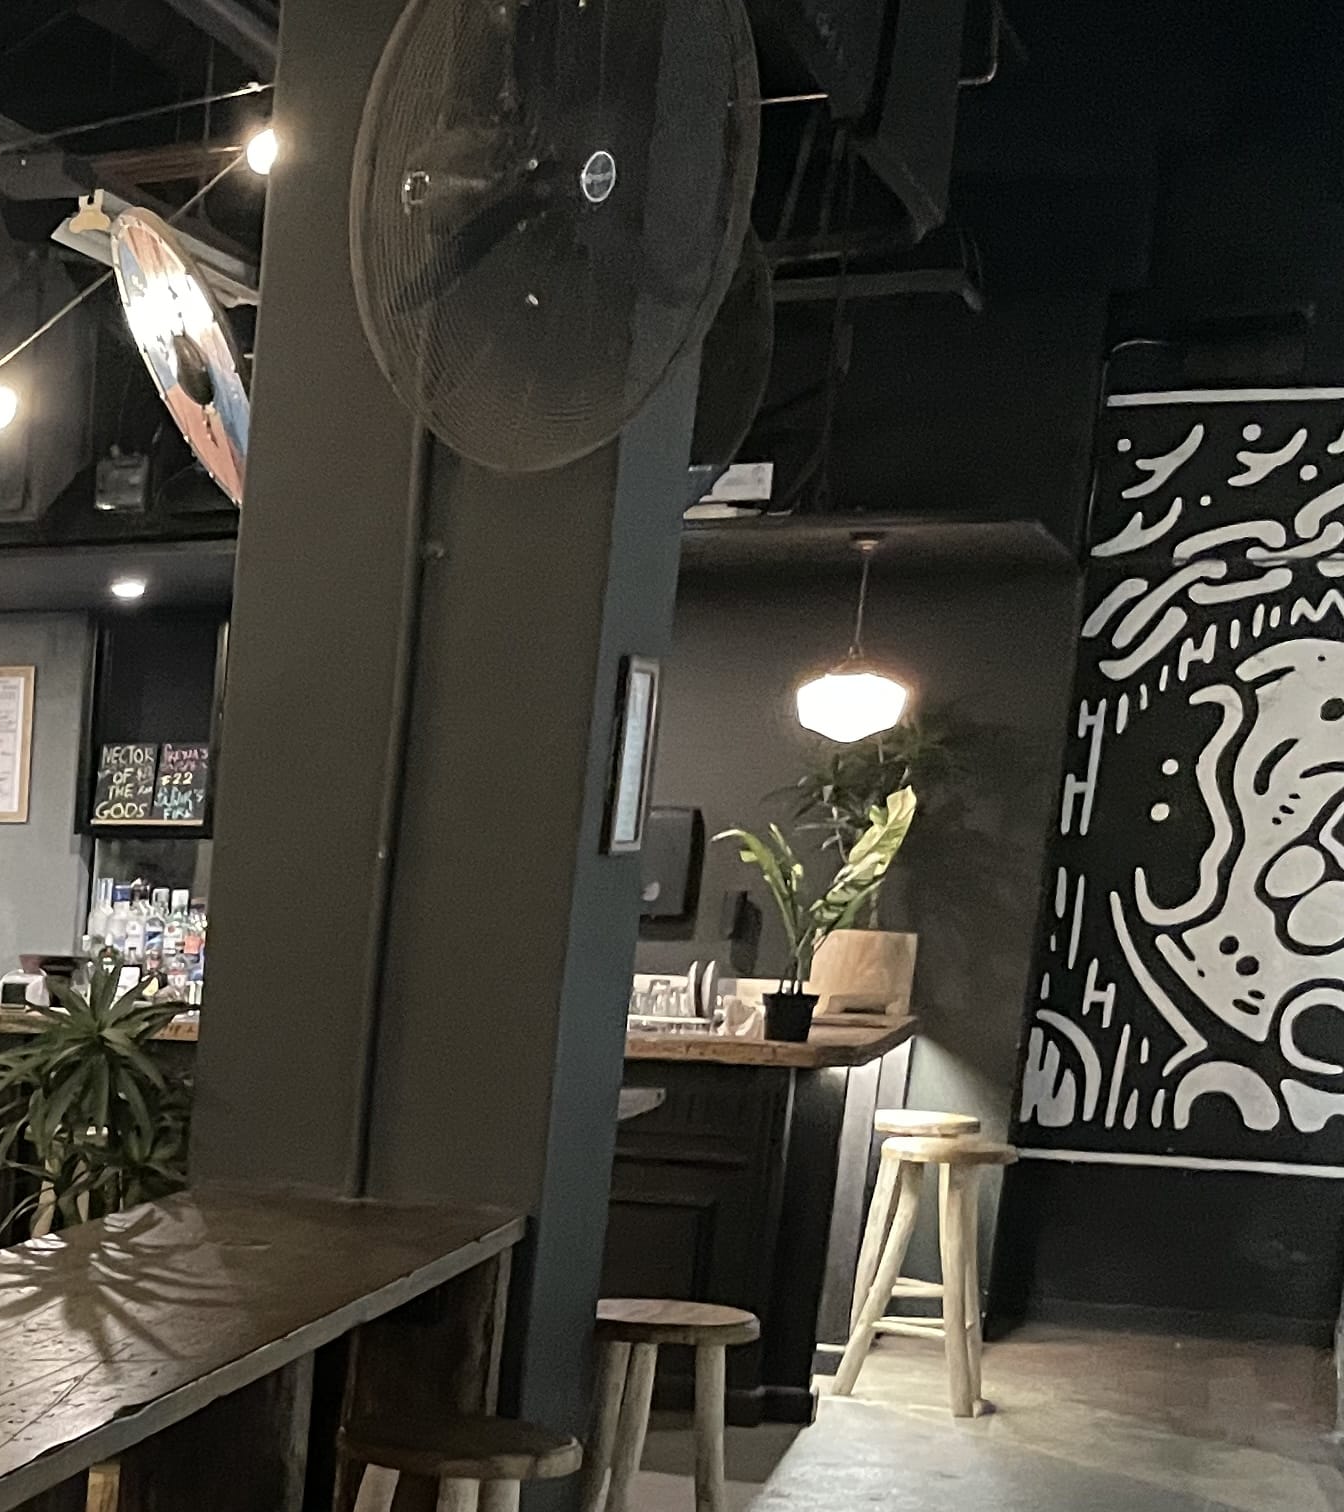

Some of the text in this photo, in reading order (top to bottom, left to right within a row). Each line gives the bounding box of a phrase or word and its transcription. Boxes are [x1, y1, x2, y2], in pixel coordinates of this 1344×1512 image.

[112, 768, 134, 785] OF
[108, 784, 134, 800] THE
[95, 801, 148, 819] GODS
